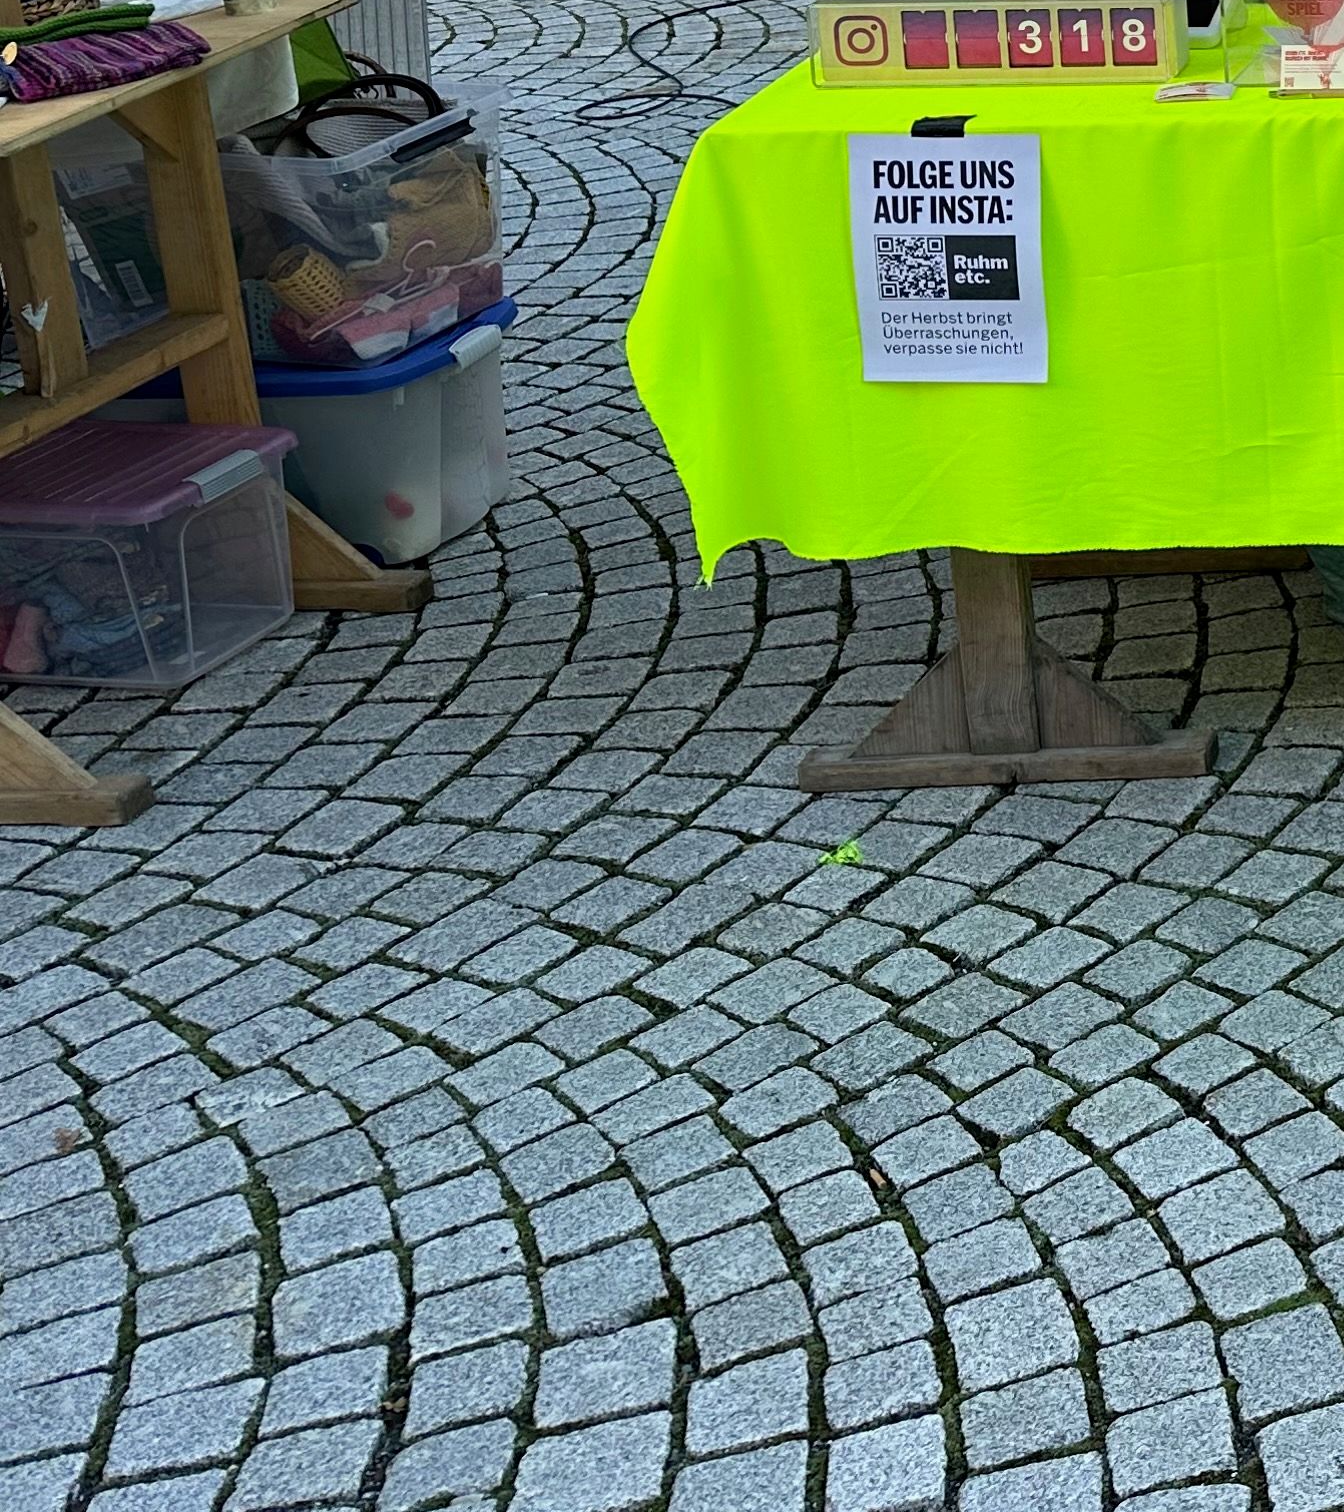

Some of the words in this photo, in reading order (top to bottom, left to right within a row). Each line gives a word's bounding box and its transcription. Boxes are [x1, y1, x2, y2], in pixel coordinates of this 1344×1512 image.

[1287, 2, 1325, 16] SPIEL
[873, 160, 954, 189] FOLGE
[960, 160, 1015, 189] UNS
[874, 196, 925, 224] AUF
[930, 196, 1013, 224] INSTA:
[953, 254, 1009, 270] Ruhm
[954, 271, 991, 284] etc.
[881, 312, 908, 324] Der
[912, 311, 964, 324] Herbst
[967, 311, 1013, 328] bringt
[883, 325, 1014, 341] Überraschungen,
[884, 344, 952, 356] verpasse
[955, 342, 977, 355] sie
[981, 342, 1024, 355] nicht!
